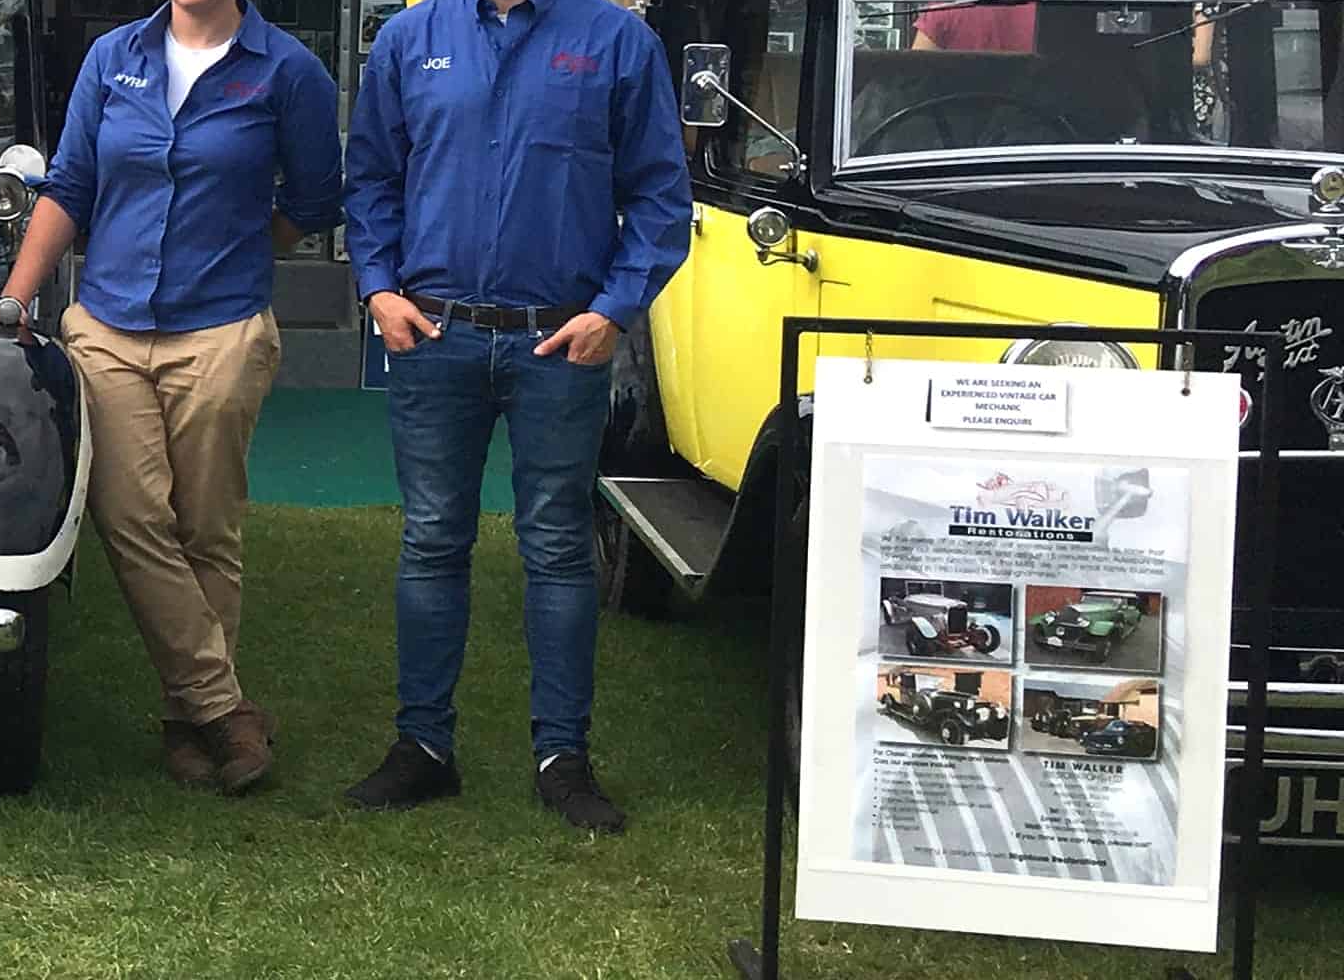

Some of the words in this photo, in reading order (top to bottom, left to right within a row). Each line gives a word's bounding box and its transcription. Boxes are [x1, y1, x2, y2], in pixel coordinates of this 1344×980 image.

[422, 55, 452, 70] JOE
[1038, 393, 1057, 401] CAR
[949, 505, 997, 525] Tim
[1005, 507, 1096, 530] Walker
[967, 526, 1075, 541] Restorations
[1071, 762, 1124, 774] WALKER
